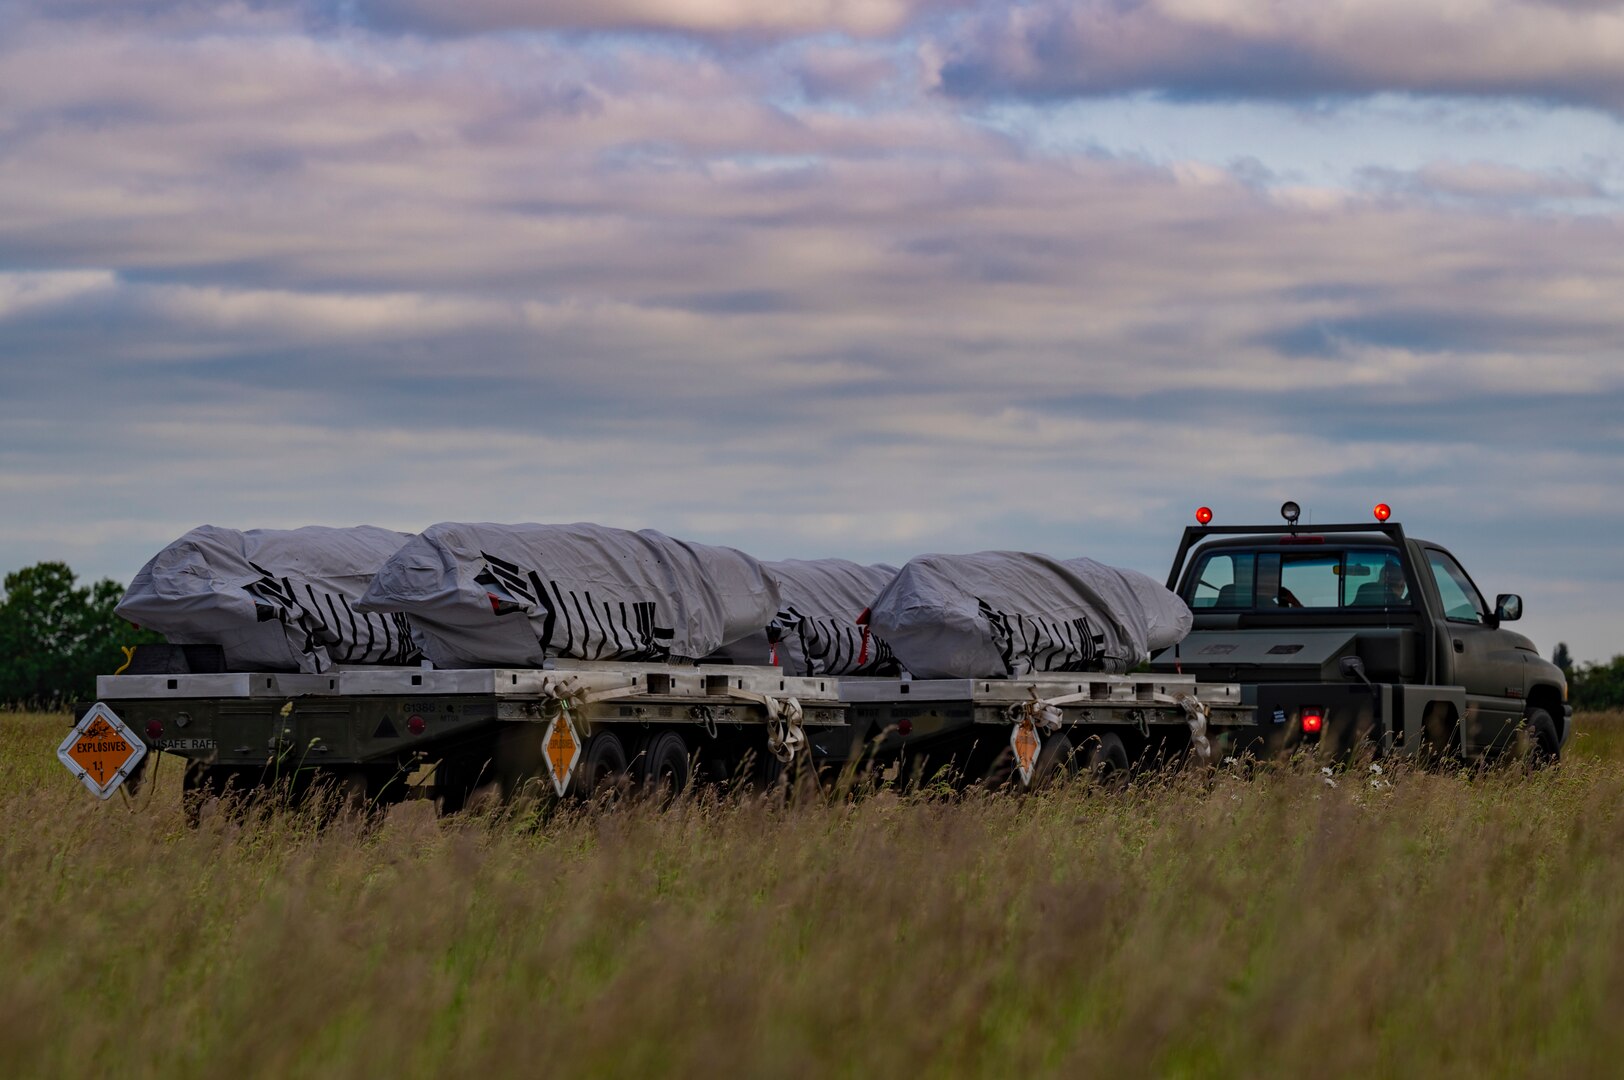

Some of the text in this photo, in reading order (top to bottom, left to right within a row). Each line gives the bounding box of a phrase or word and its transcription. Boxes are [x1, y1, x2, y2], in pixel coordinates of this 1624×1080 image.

[77, 741, 127, 753] EXPLOSIVES
[153, 739, 187, 750] USAFE
[92, 760, 104, 771] 1.1
